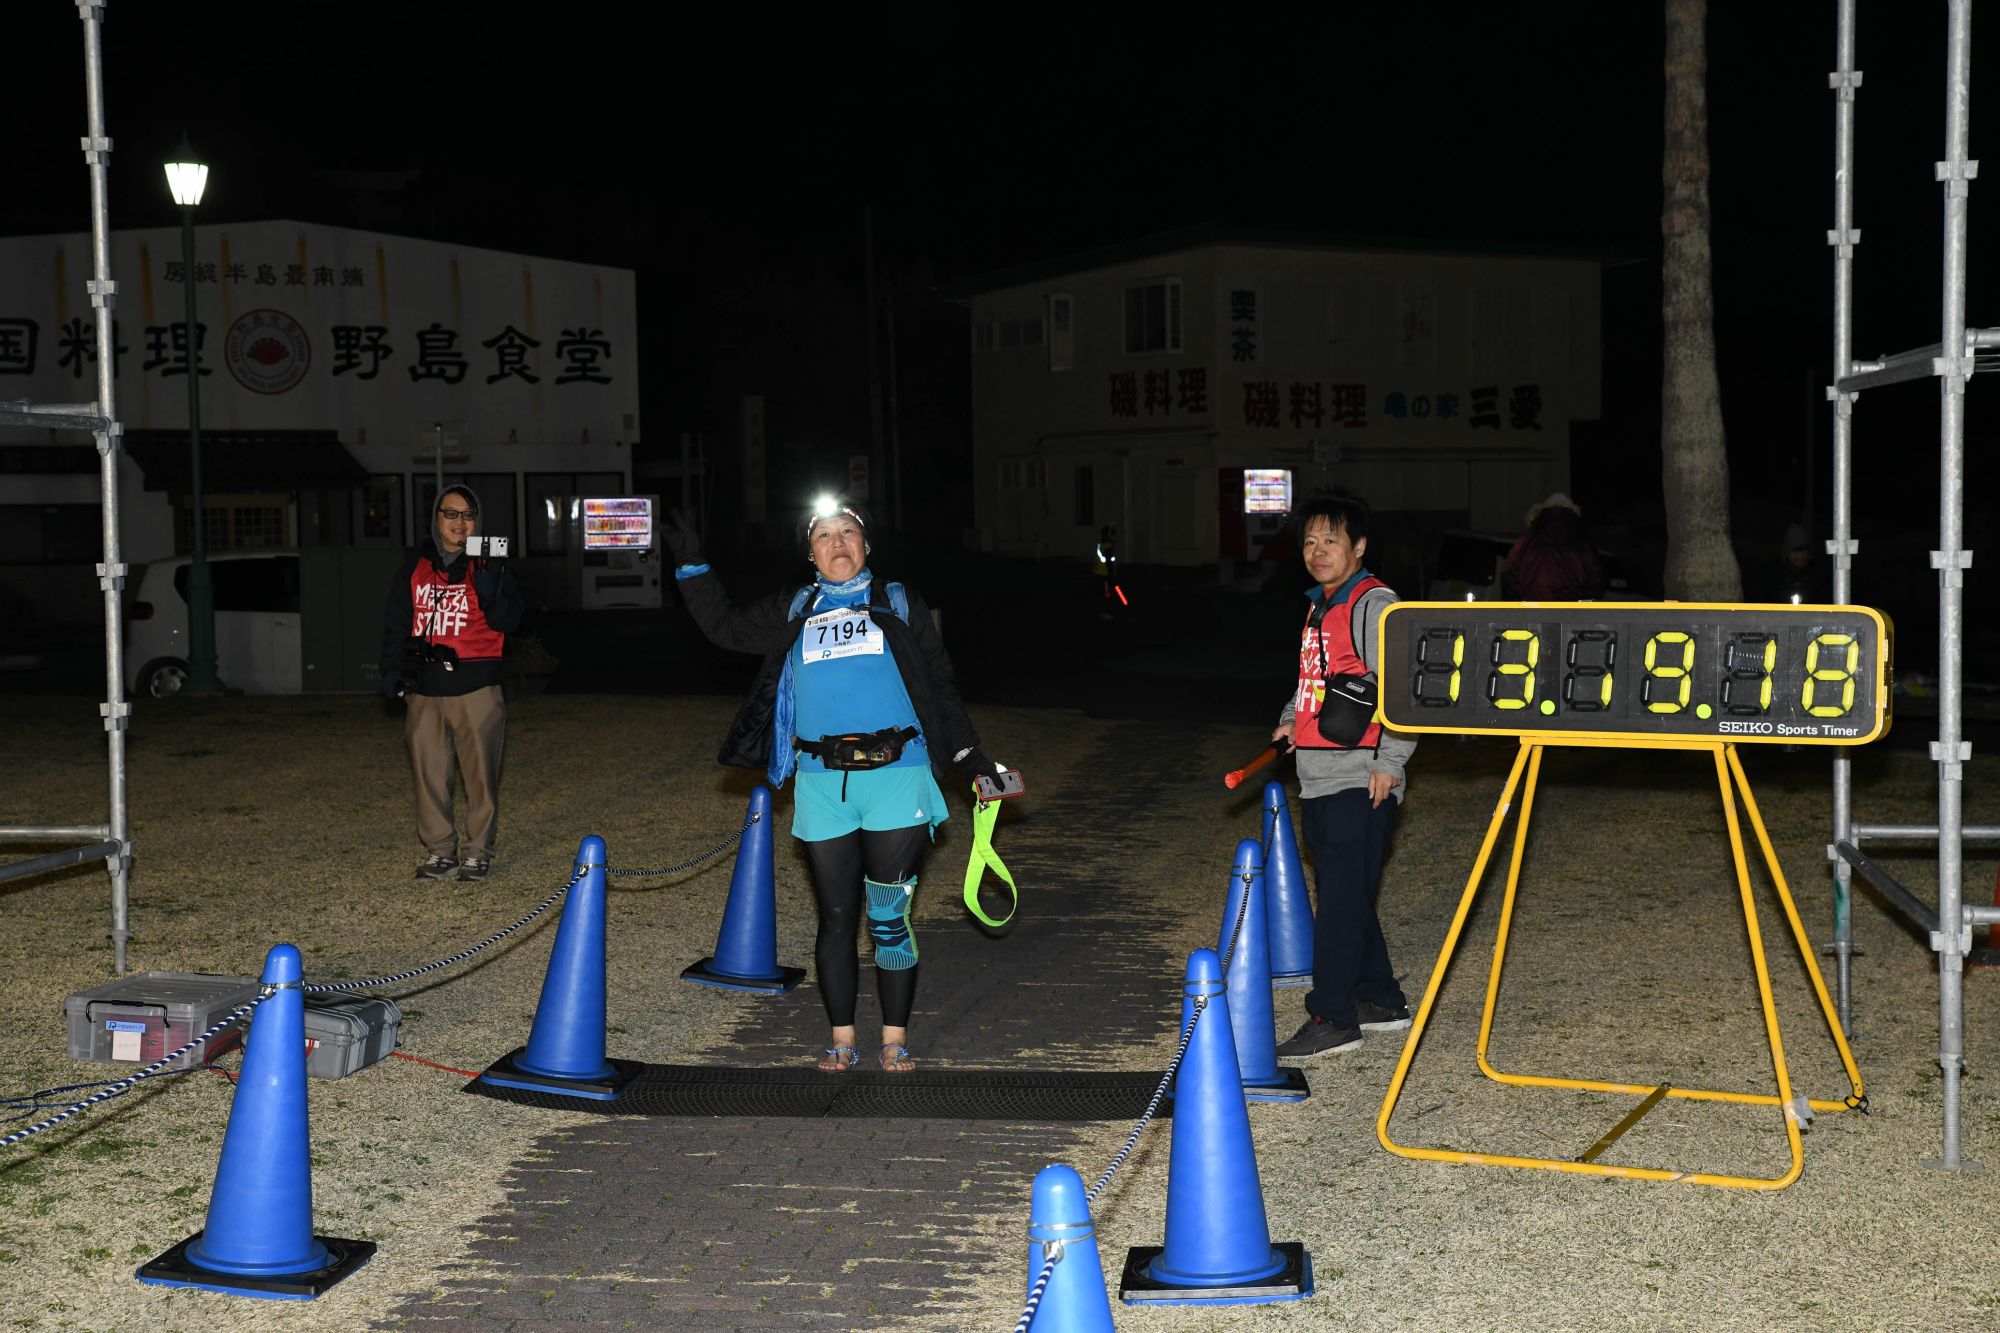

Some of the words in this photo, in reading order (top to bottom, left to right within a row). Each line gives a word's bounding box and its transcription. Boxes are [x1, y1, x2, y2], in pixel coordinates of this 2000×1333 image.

[165, 260, 364, 287] 房総半島最南端
[1231, 290, 1256, 362] 喫茶
[330, 323, 613, 386] 野島食堂
[1109, 367, 1208, 418] 磯料理
[1243, 382, 1367, 429] 磯料理
[415, 611, 468, 636] STAFF
[817, 619, 868, 644] 7194
[1718, 721, 1773, 734] SEIKO
[1777, 723, 1818, 736] Sports
[1821, 724, 1859, 736] Timer
